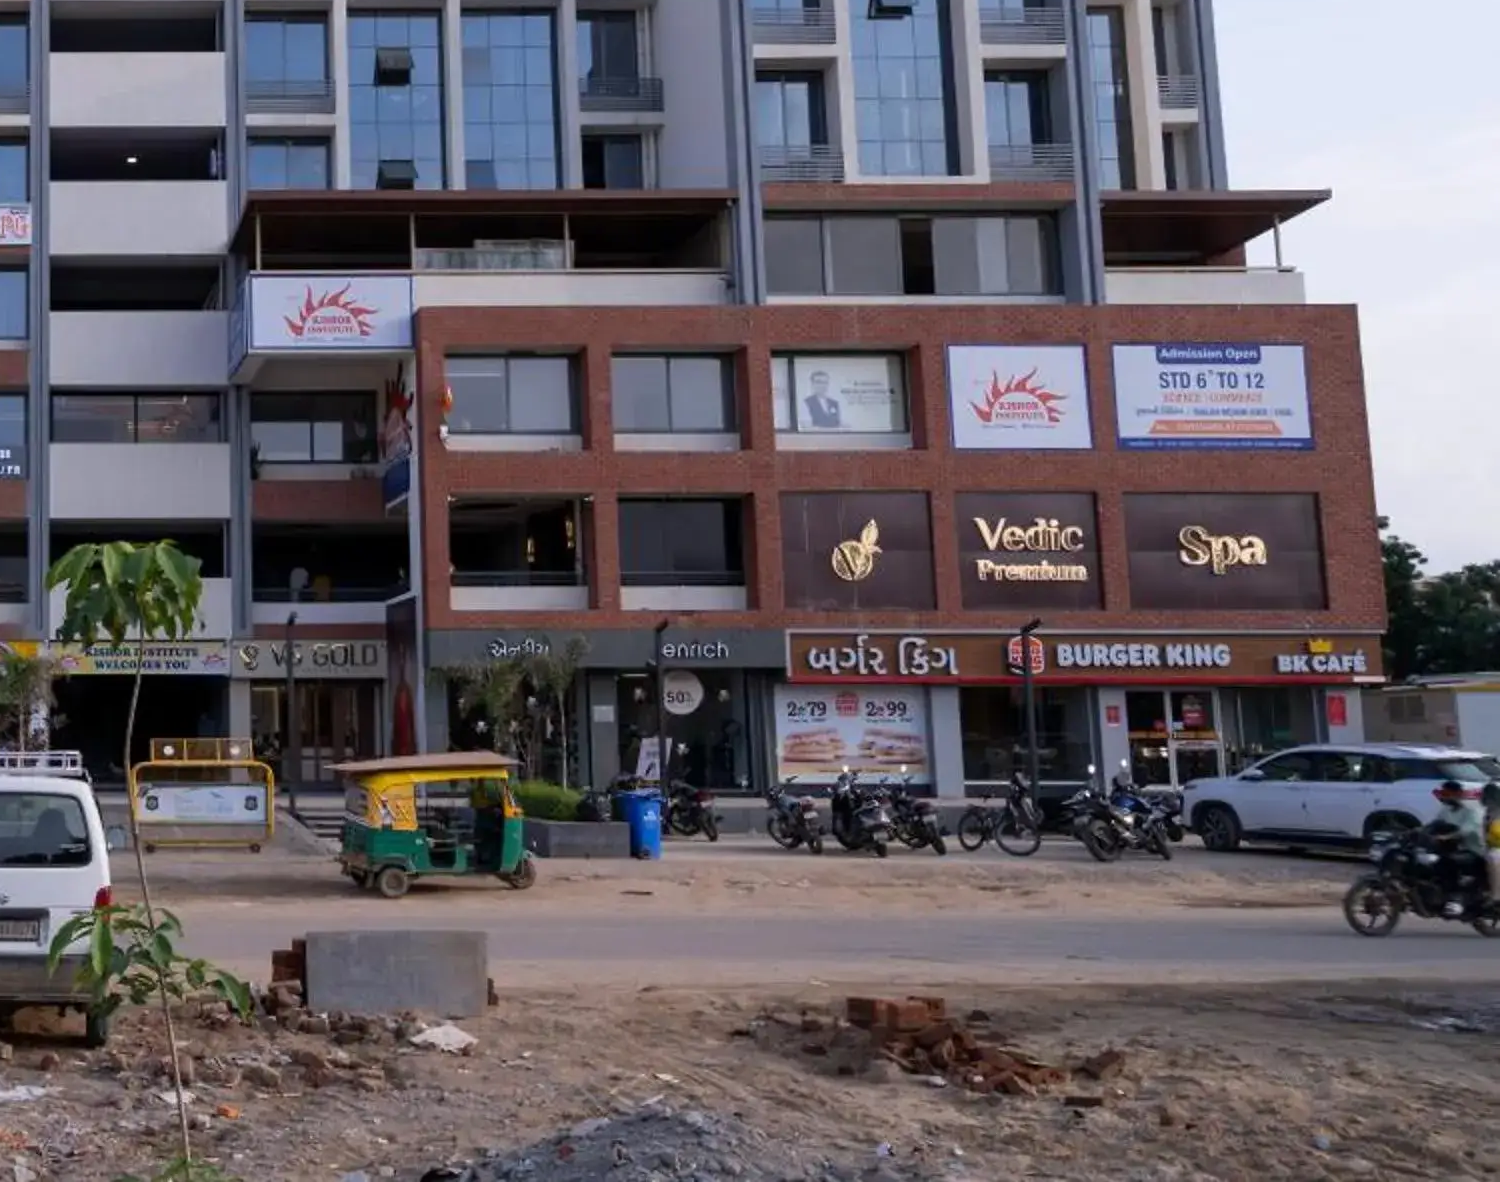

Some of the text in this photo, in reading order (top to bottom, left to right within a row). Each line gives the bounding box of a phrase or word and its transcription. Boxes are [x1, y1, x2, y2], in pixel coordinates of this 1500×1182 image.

[1159, 347, 1258, 360] Admission Open
[1159, 372, 1191, 389] STD
[1217, 372, 1239, 389] TO
[1246, 372, 1265, 389] 12
[973, 517, 1085, 551] Vedic
[1178, 525, 1267, 575] Spa
[975, 559, 1088, 581] Premium
[312, 643, 378, 667] GOLD
[662, 641, 729, 659] enrich
[1056, 644, 1161, 667] BURGER
[1165, 644, 1231, 667] KING
[1277, 648, 1367, 673] BK CAFÉ
[165, 659, 190, 670] YOU
